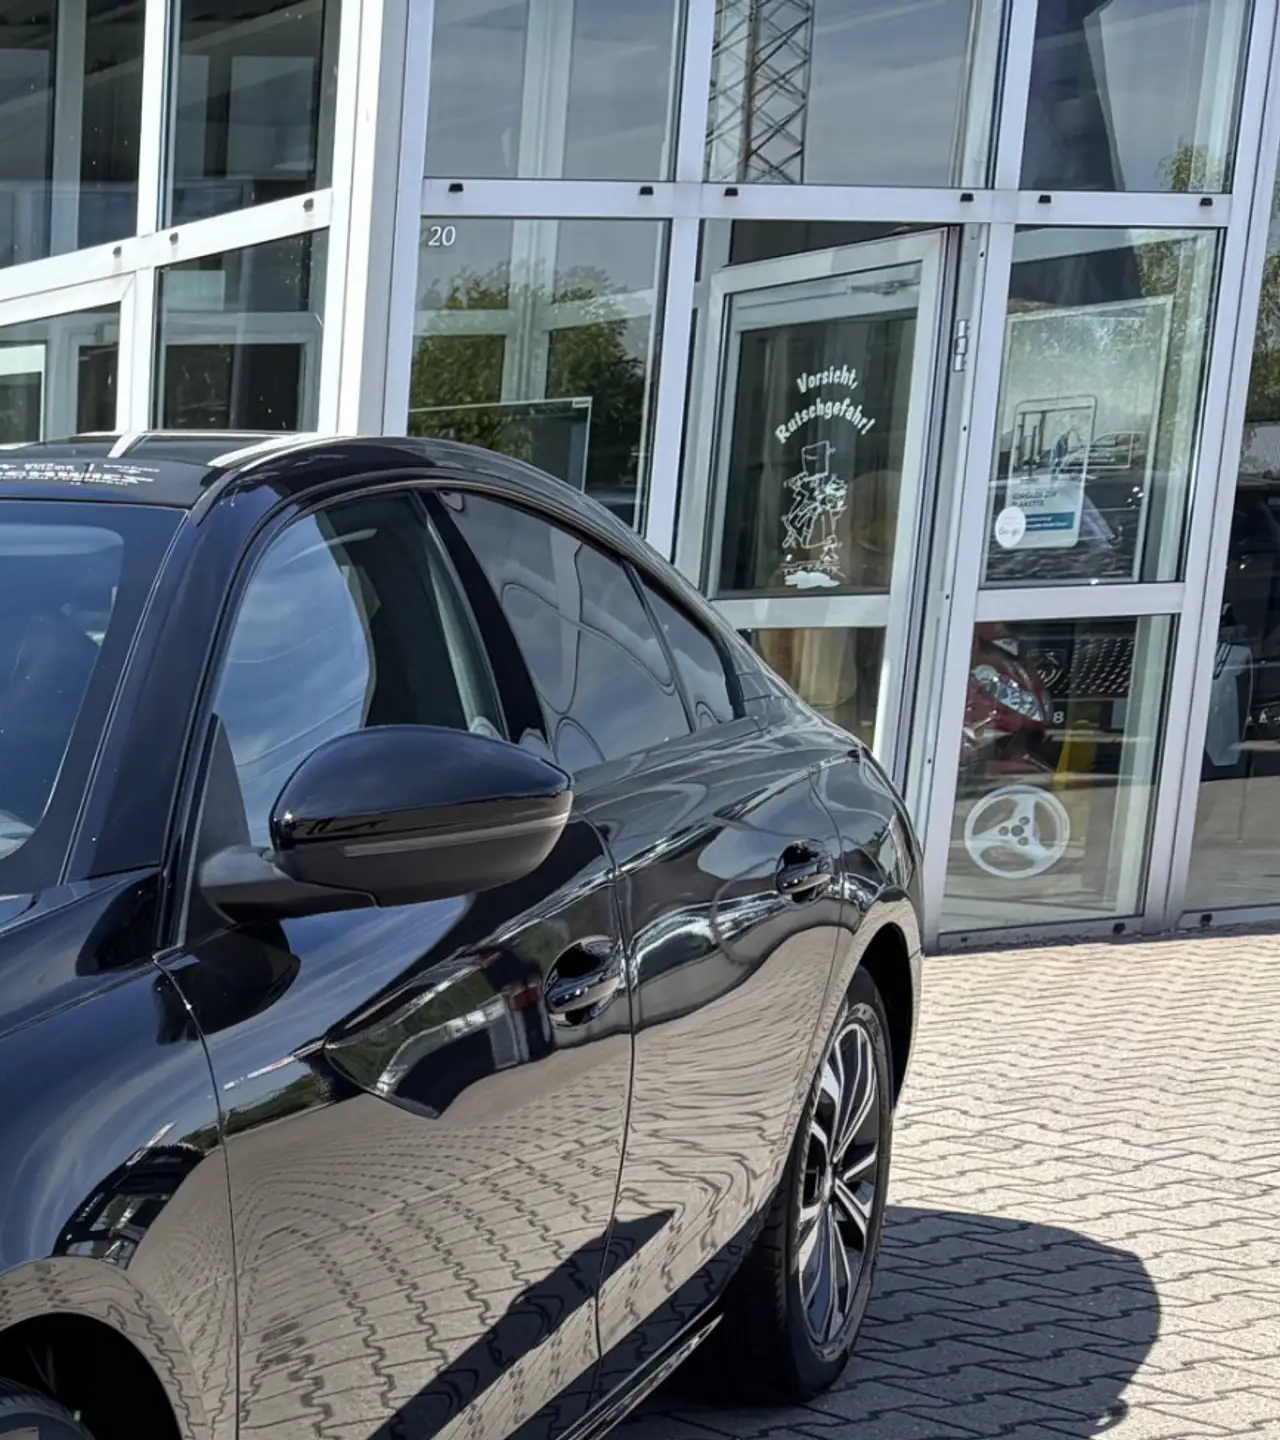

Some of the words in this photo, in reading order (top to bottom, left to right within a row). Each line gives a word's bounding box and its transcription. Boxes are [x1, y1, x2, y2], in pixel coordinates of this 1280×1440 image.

[428, 225, 456, 247] 20
[796, 364, 858, 395] Vorsicht,
[774, 397, 876, 446] Rutschgefahr!
